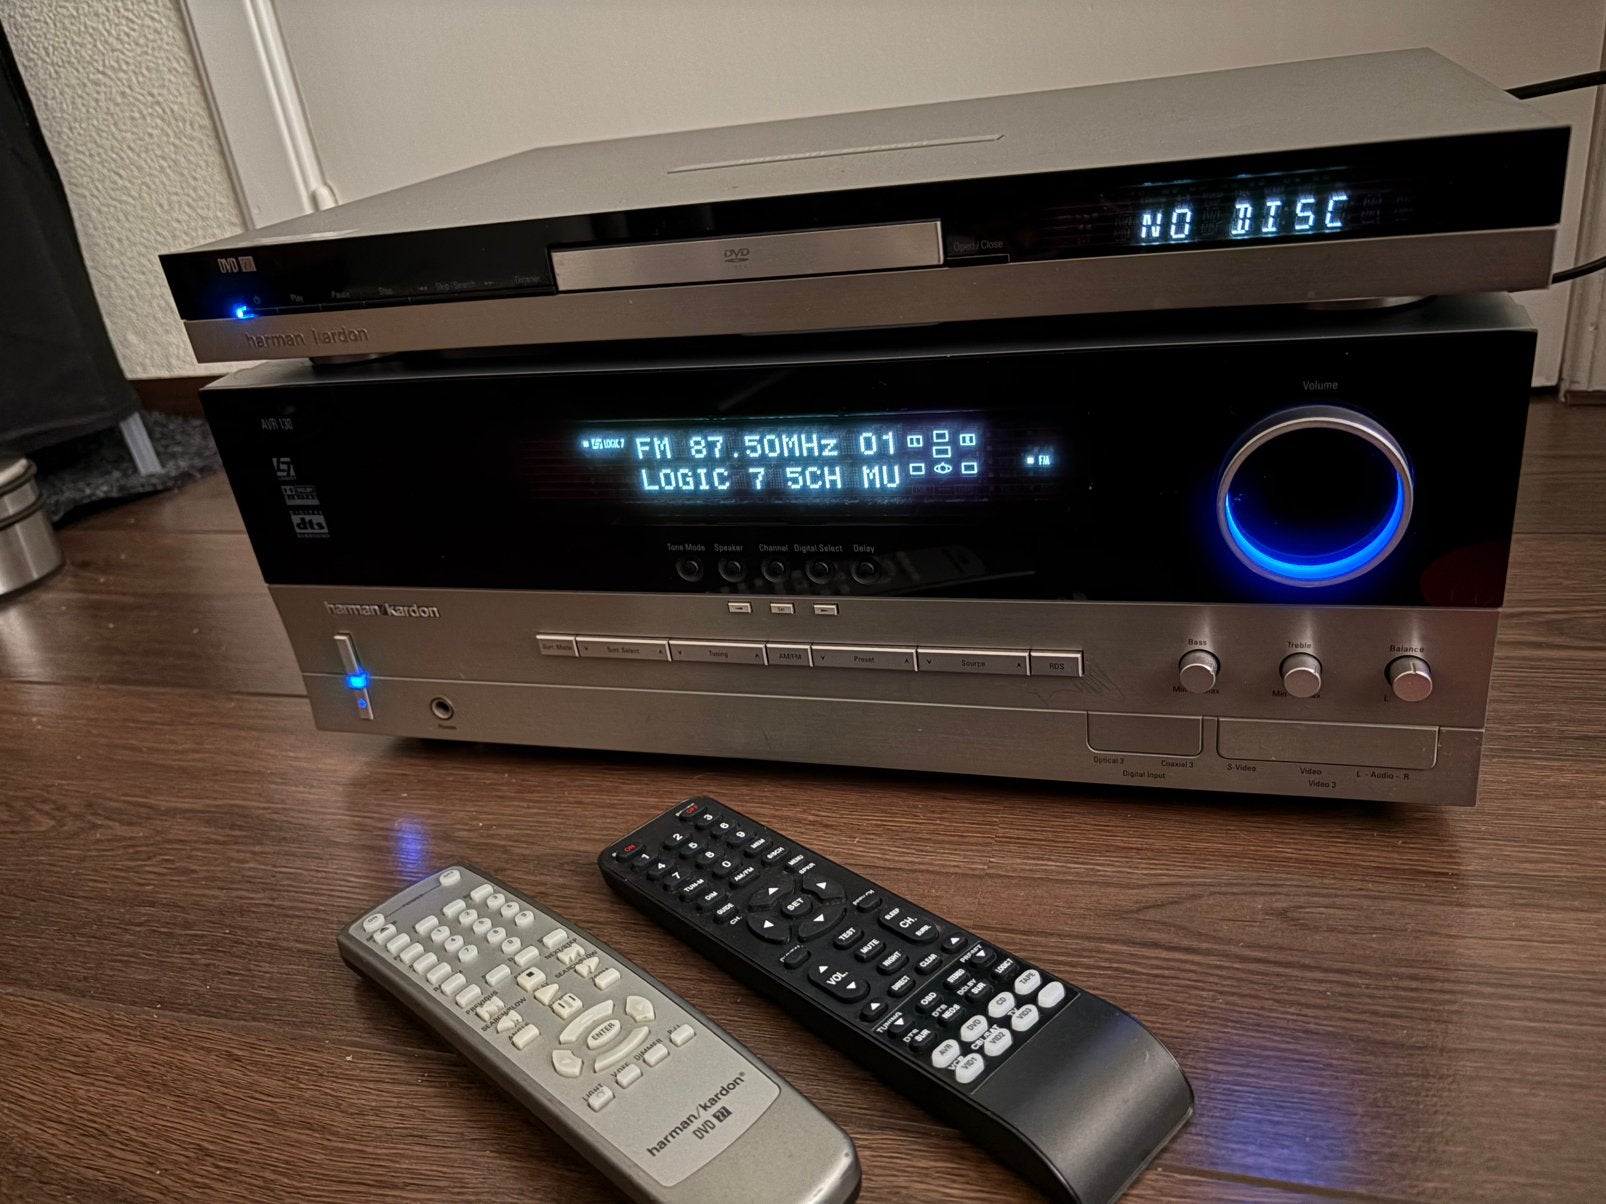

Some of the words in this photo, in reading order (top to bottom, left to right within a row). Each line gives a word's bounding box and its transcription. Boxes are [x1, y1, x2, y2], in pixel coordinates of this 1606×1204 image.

[1141, 208, 1192, 238] NO
[1231, 193, 1347, 235] DISC
[724, 248, 750, 262] DVD
[217, 258, 239, 273] DVD
[1302, 380, 1338, 390] Volume
[635, 437, 672, 460] FM
[690, 433, 838, 459] 87.50MHz
[860, 431, 895, 456] 01
[1038, 455, 1050, 466] FM
[641, 468, 730, 491] LOGIC
[749, 467, 765, 490] 7
[786, 466, 842, 489] 5CH
[862, 464, 900, 489] MU
[714, 544, 744, 552] Speaker
[794, 544, 817, 553] Digital
[853, 545, 875, 553] Delay
[1288, 641, 1312, 649] Treble
[1390, 645, 1424, 653] Balance
[779, 652, 802, 660] AM/FM
[853, 655, 875, 664] Preset
[961, 659, 986, 667] Source
[1049, 662, 1065, 670] RDS
[1093, 756, 1117, 765] Optical
[1161, 760, 1188, 768] Coaxial
[1227, 763, 1257, 772] S-Video
[1122, 770, 1146, 779] Digital
[1147, 771, 1166, 780] Input
[1370, 772, 1394, 780] Audio
[1308, 780, 1330, 788] Video
[672, 833, 683, 841] 2
[750, 838, 765, 849] MEM
[672, 872, 681, 880] 7
[734, 867, 754, 882] AM/FM
[705, 891, 718, 901] DIM
[716, 902, 735, 915] GUIDE
[787, 897, 804, 911] SET
[885, 907, 900, 920] SLEEP
[899, 917, 918, 928] CH.
[838, 927, 856, 941] TEST
[860, 938, 880, 954] MUTE
[882, 951, 902, 967] NIGHT
[919, 953, 938, 968] CLEAR
[826, 971, 849, 986] VOL.
[891, 975, 910, 991] DIRECT
[1019, 972, 1036, 985] TAPE
[956, 978, 977, 996] DOLBY
[465, 990, 498, 1015] PREVIOUS
[920, 992, 937, 1005] OSD
[995, 996, 1007, 1006] CD
[1016, 1007, 1033, 1020] VID3
[966, 1019, 982, 1031] DVD
[591, 1022, 615, 1041] ENTER
[971, 1024, 1000, 1050] CBL/SAT
[989, 1031, 1006, 1044] VID2
[633, 1038, 663, 1061] DIMMER
[939, 1043, 953, 1055] AVR
[960, 1056, 978, 1070] VID1
[692, 1120, 716, 1140] DVD
